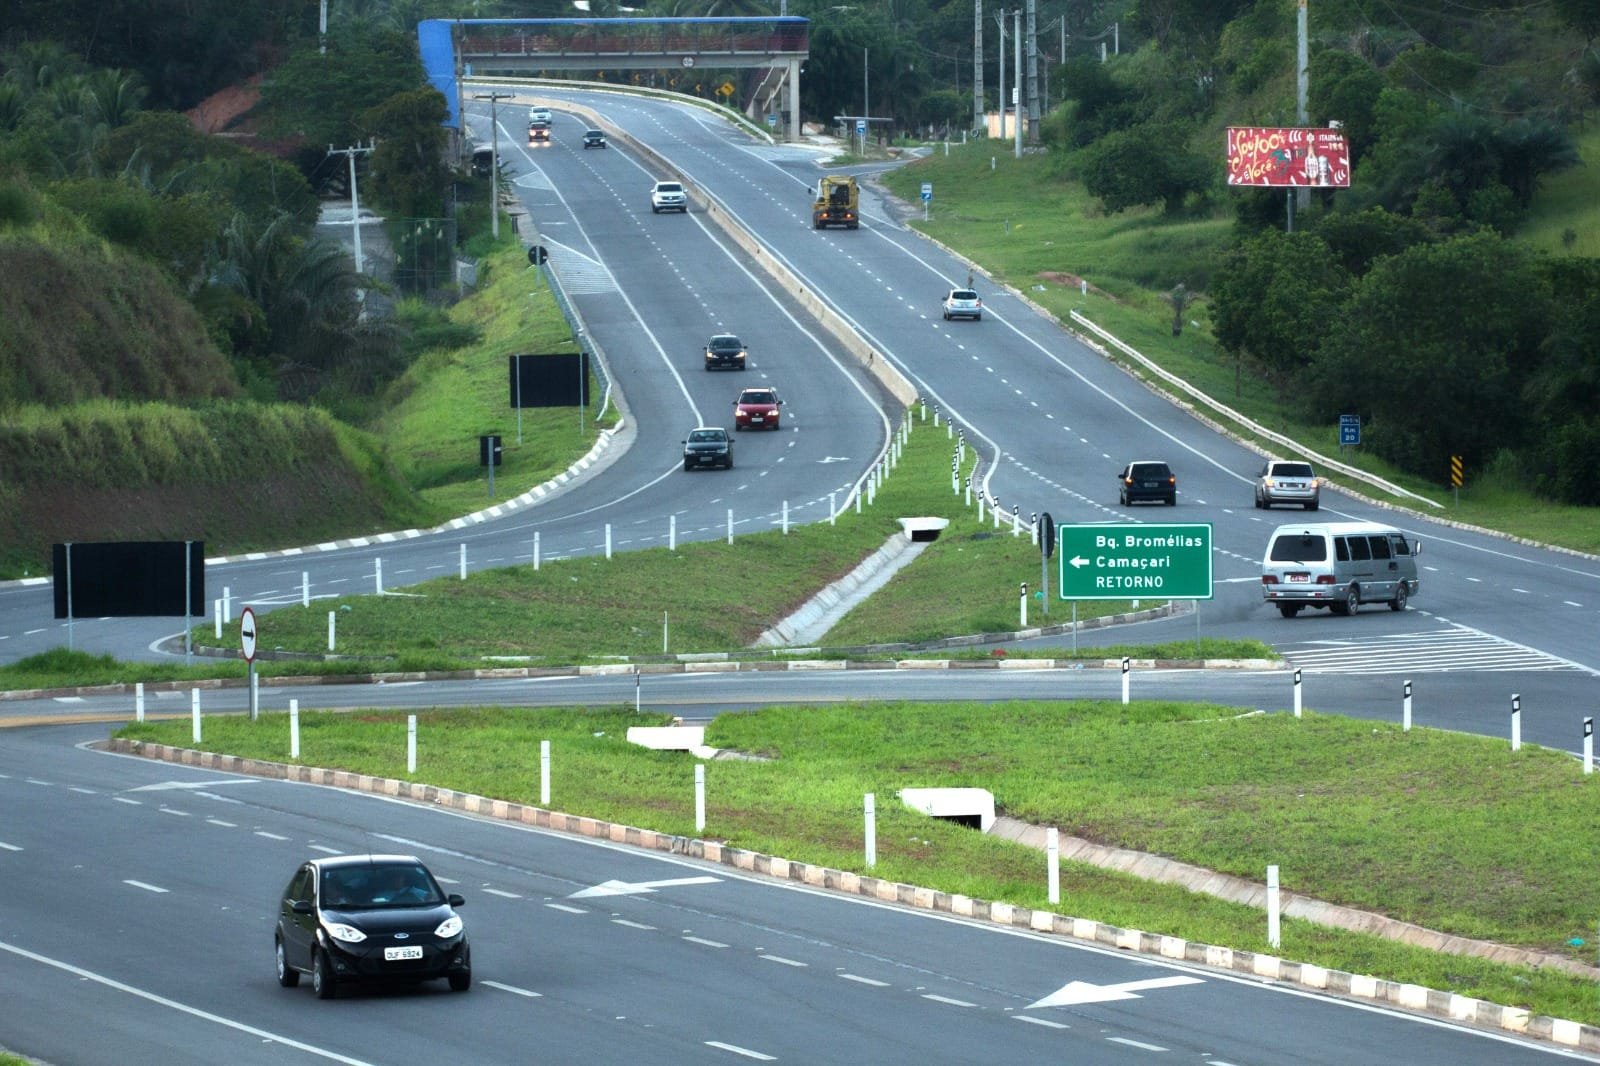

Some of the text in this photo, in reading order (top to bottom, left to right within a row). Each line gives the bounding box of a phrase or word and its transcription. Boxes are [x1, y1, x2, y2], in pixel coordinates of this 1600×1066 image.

[1096, 534, 1202, 549] Bq. Bromélias
[1096, 555, 1170, 569] Camaçari
[1096, 576, 1163, 588] RETORNO
